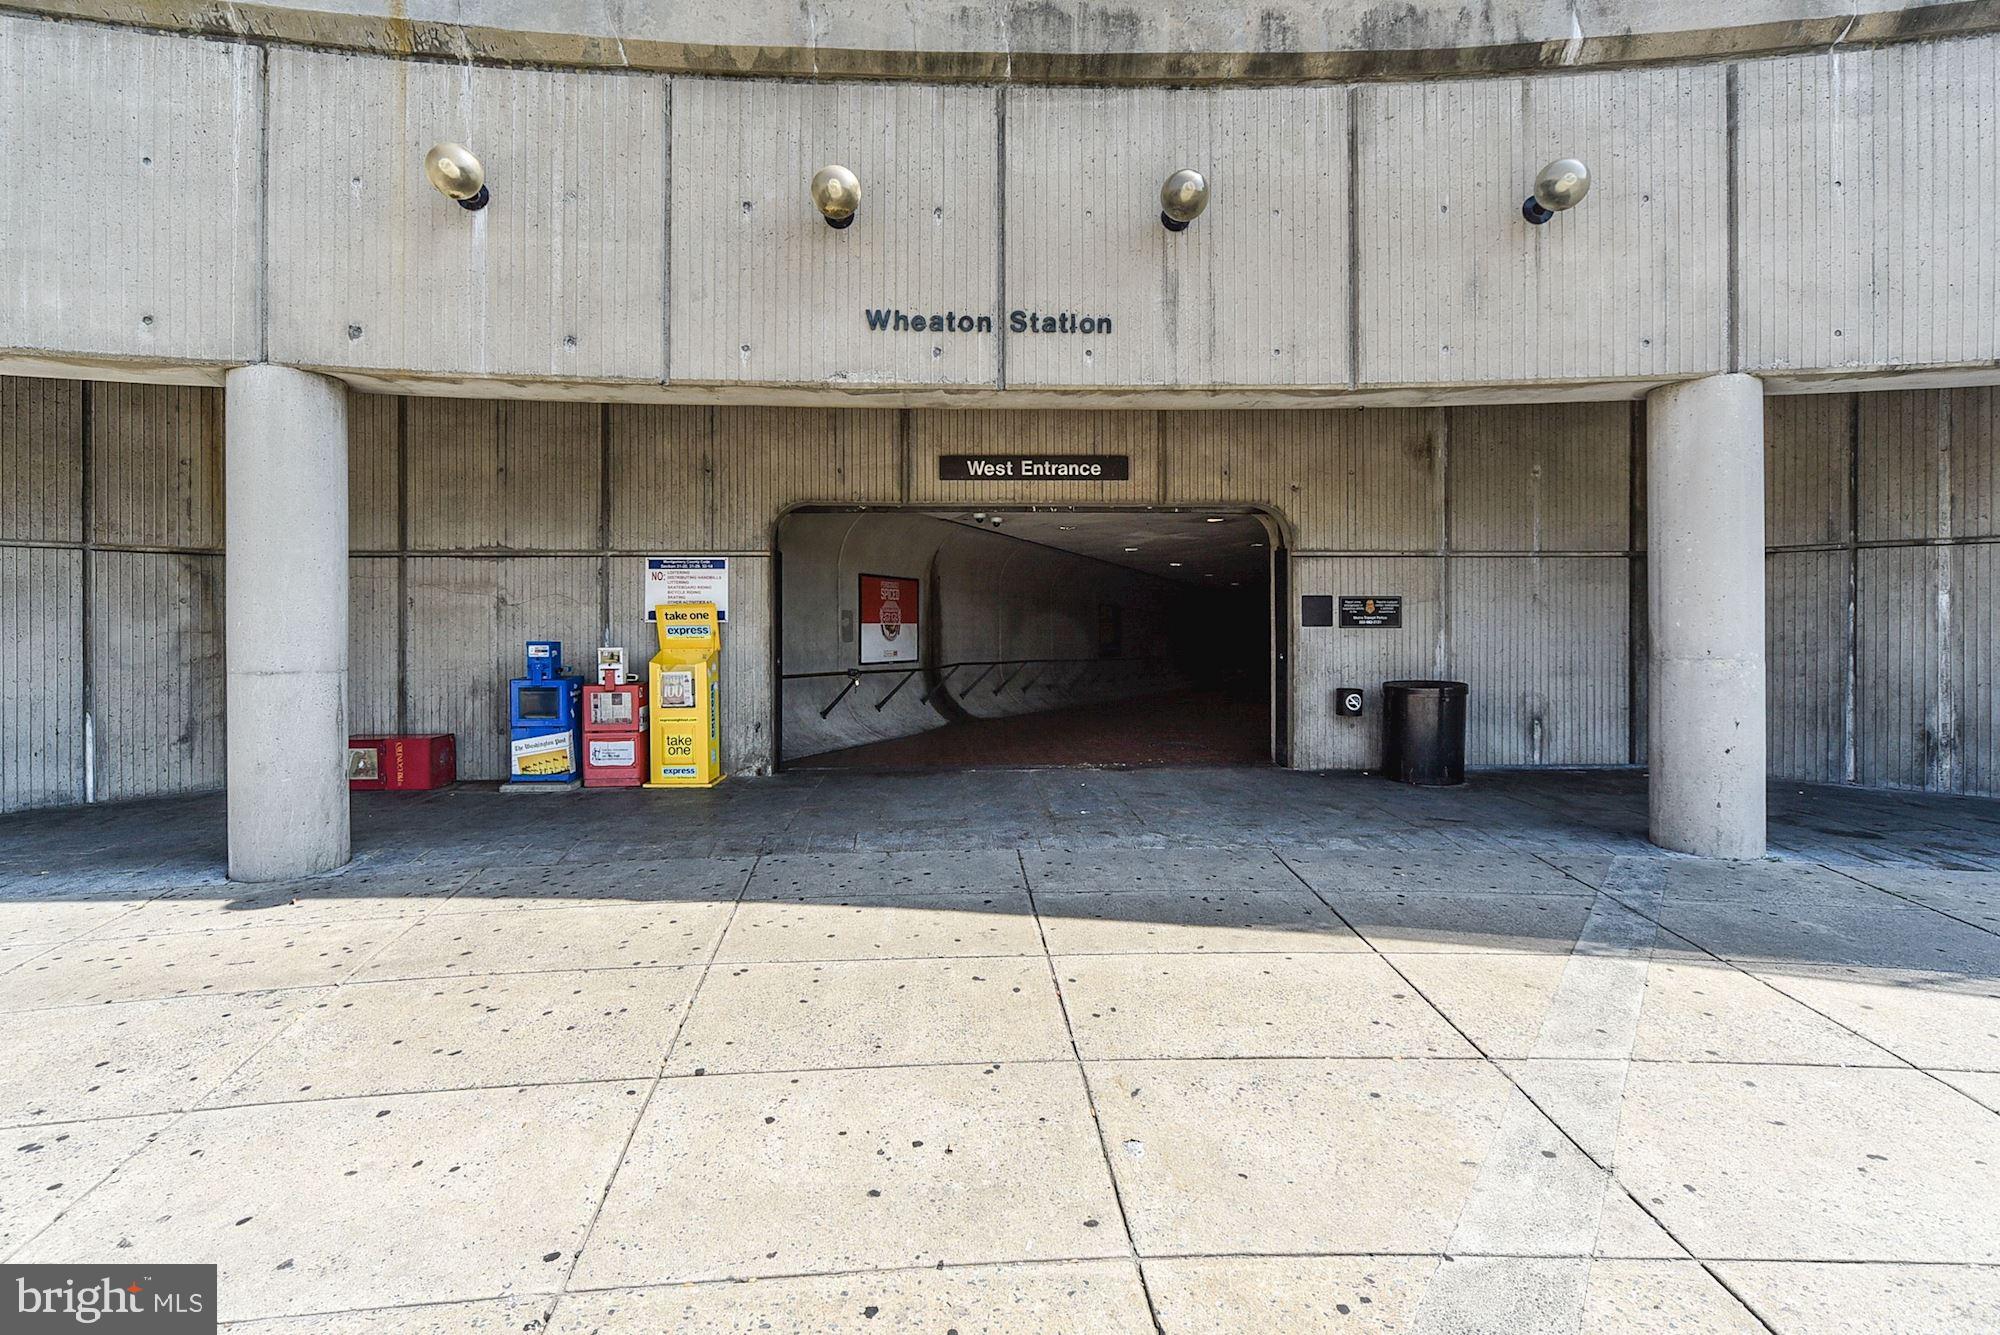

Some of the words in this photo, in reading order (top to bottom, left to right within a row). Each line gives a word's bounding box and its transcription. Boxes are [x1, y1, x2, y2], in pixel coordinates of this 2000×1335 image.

[865, 309, 992, 333] Wheaton
[1009, 310, 1112, 334] Station
[966, 460, 1014, 476] West
[1021, 460, 1102, 476] Entrance
[665, 611, 688, 620] take
[689, 612, 710, 620] one
[667, 627, 709, 636] express
[666, 735, 692, 746] take
[668, 746, 691, 756] one
